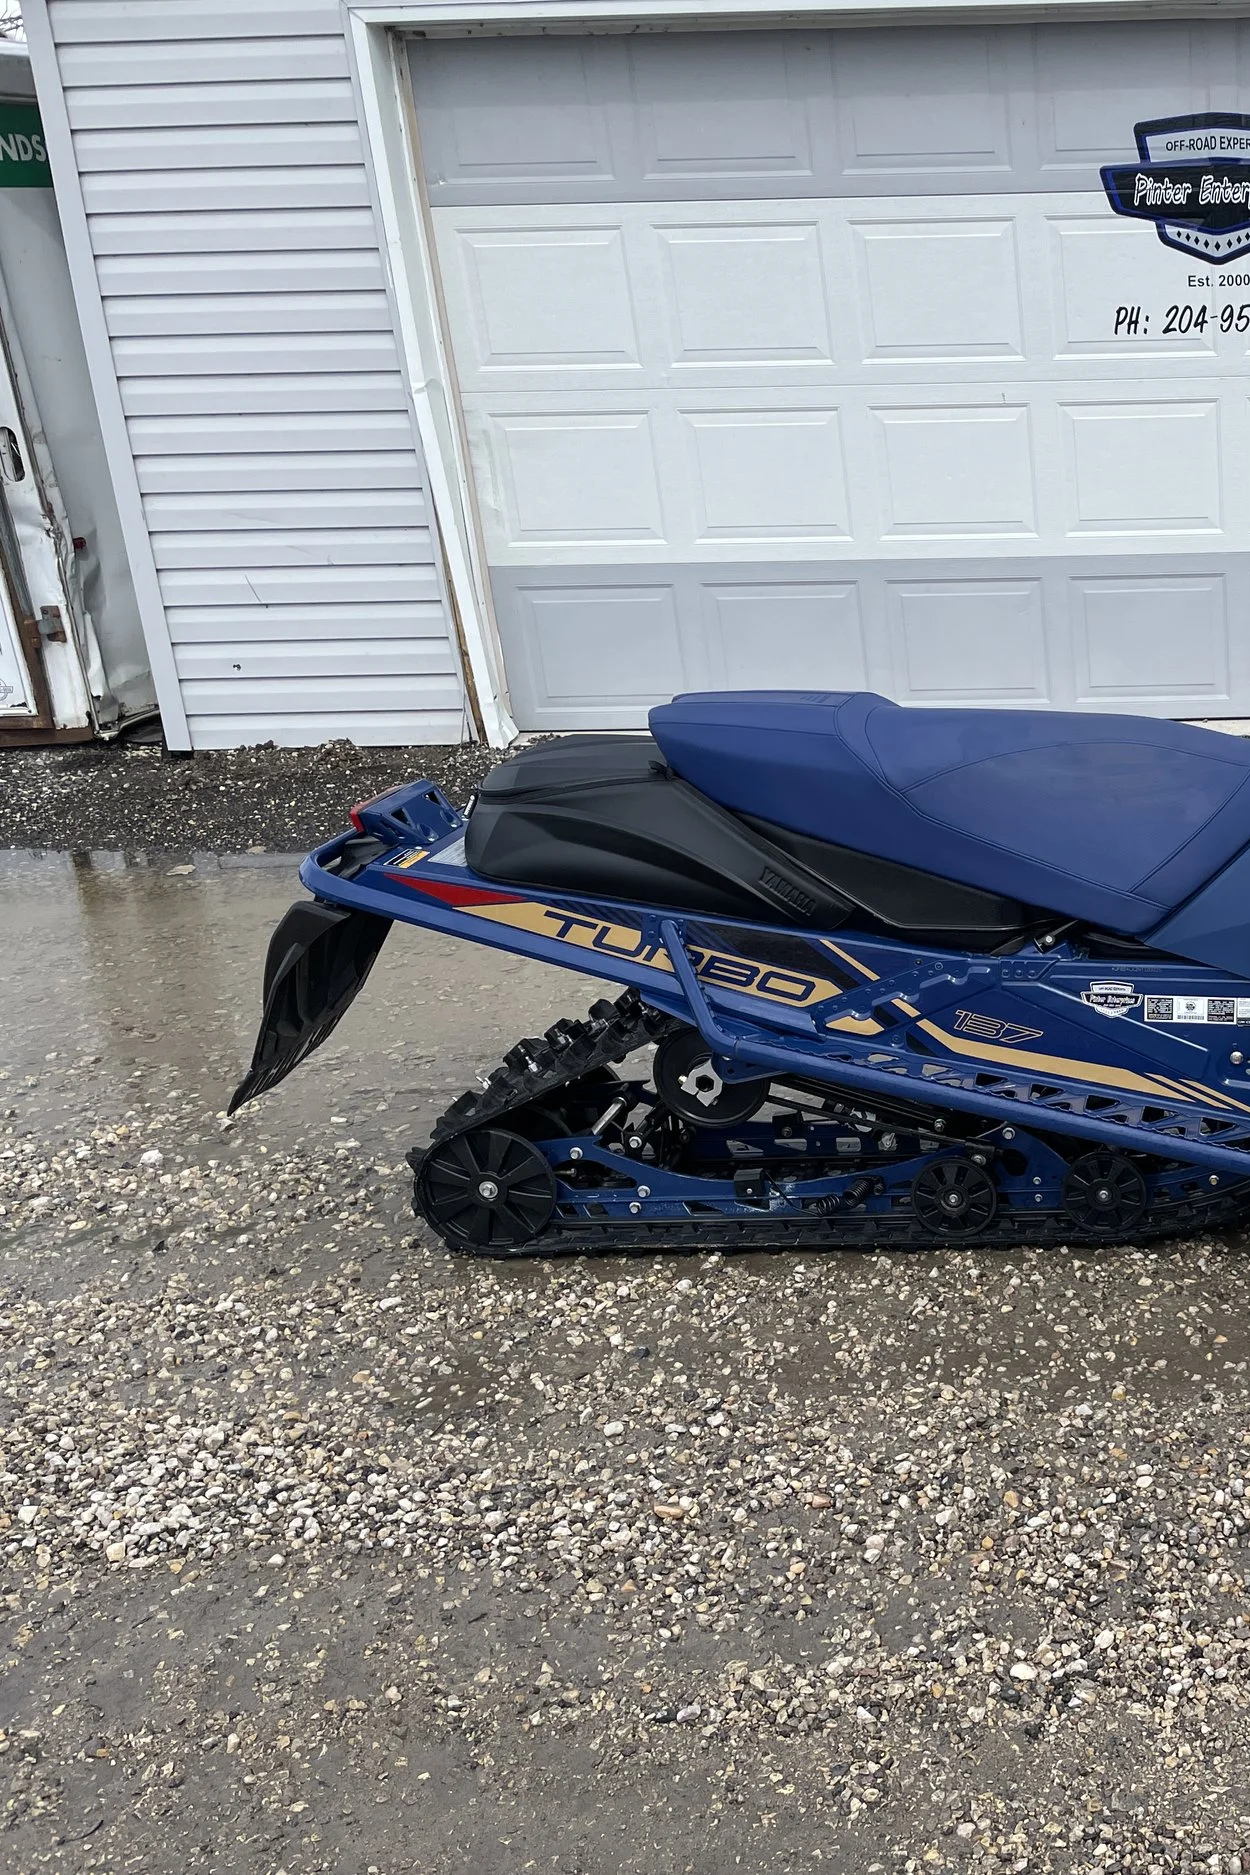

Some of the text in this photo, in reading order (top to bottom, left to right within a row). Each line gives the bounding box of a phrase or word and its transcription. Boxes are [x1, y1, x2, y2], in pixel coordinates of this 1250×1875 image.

[1166, 136, 1217, 151] OFF-ROAD
[1134, 173, 1192, 206] Pinter
[1188, 274, 1250, 287] Est. 2000
[1114, 306, 1150, 335] PH:
[759, 866, 816, 916] YAMAHA
[544, 910, 815, 1001] TURBO
[954, 1010, 1044, 1043] 137
